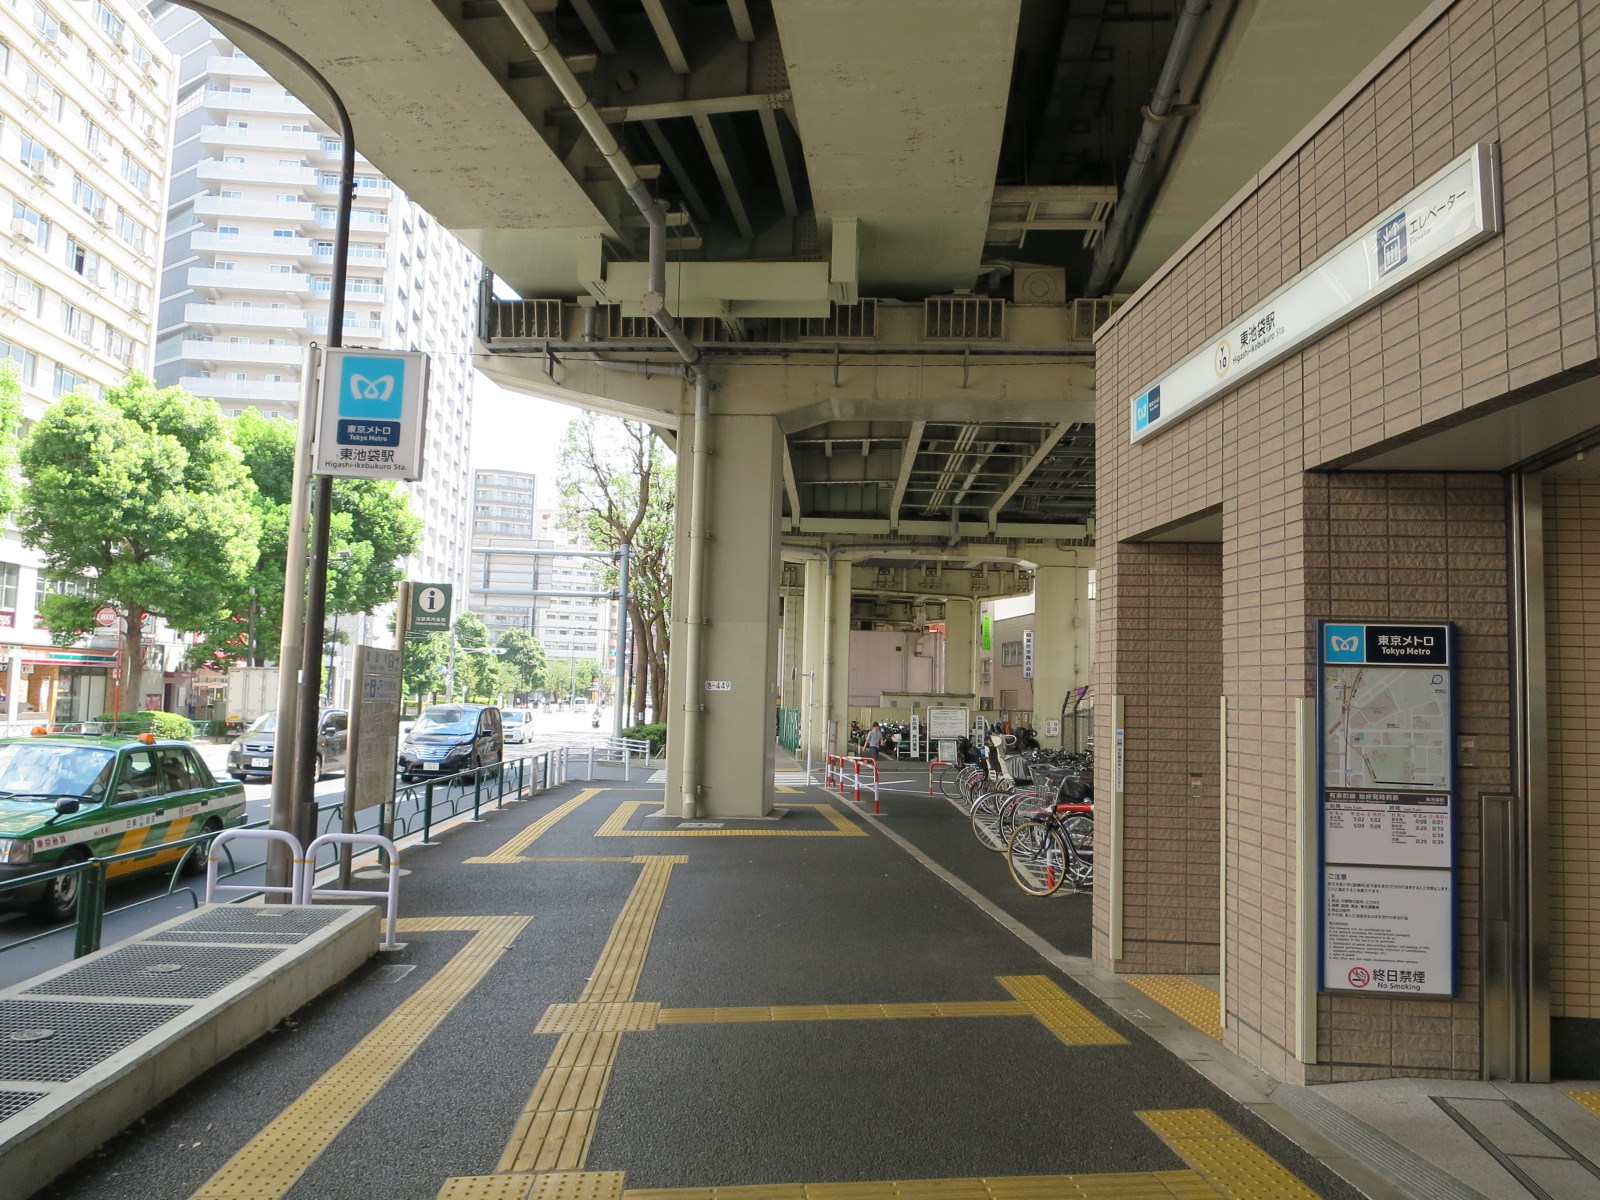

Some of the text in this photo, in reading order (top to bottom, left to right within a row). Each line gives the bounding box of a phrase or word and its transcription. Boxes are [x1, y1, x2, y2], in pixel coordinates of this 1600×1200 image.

[1410, 191, 1466, 235] エレベーター
[1410, 227, 1432, 246] Elevator
[1240, 311, 1276, 349] 東池袋駅
[1220, 346, 1225, 355] Y
[1232, 328, 1285, 364] Higashi-ikebukuro Sta.
[1219, 356, 1227, 370] 10
[347, 425, 391, 435] 東京メトロ
[350, 434, 367, 442] Tokyo
[340, 448, 394, 462] 東池袋駅
[325, 461, 392, 470] Higashi-ikebukuro
[1378, 635, 1434, 646] 東京メトロ
[1381, 647, 1404, 656] Tokyo
[1372, 969, 1426, 984] 終日禁煙
[1390, 982, 1420, 991] Smoking
